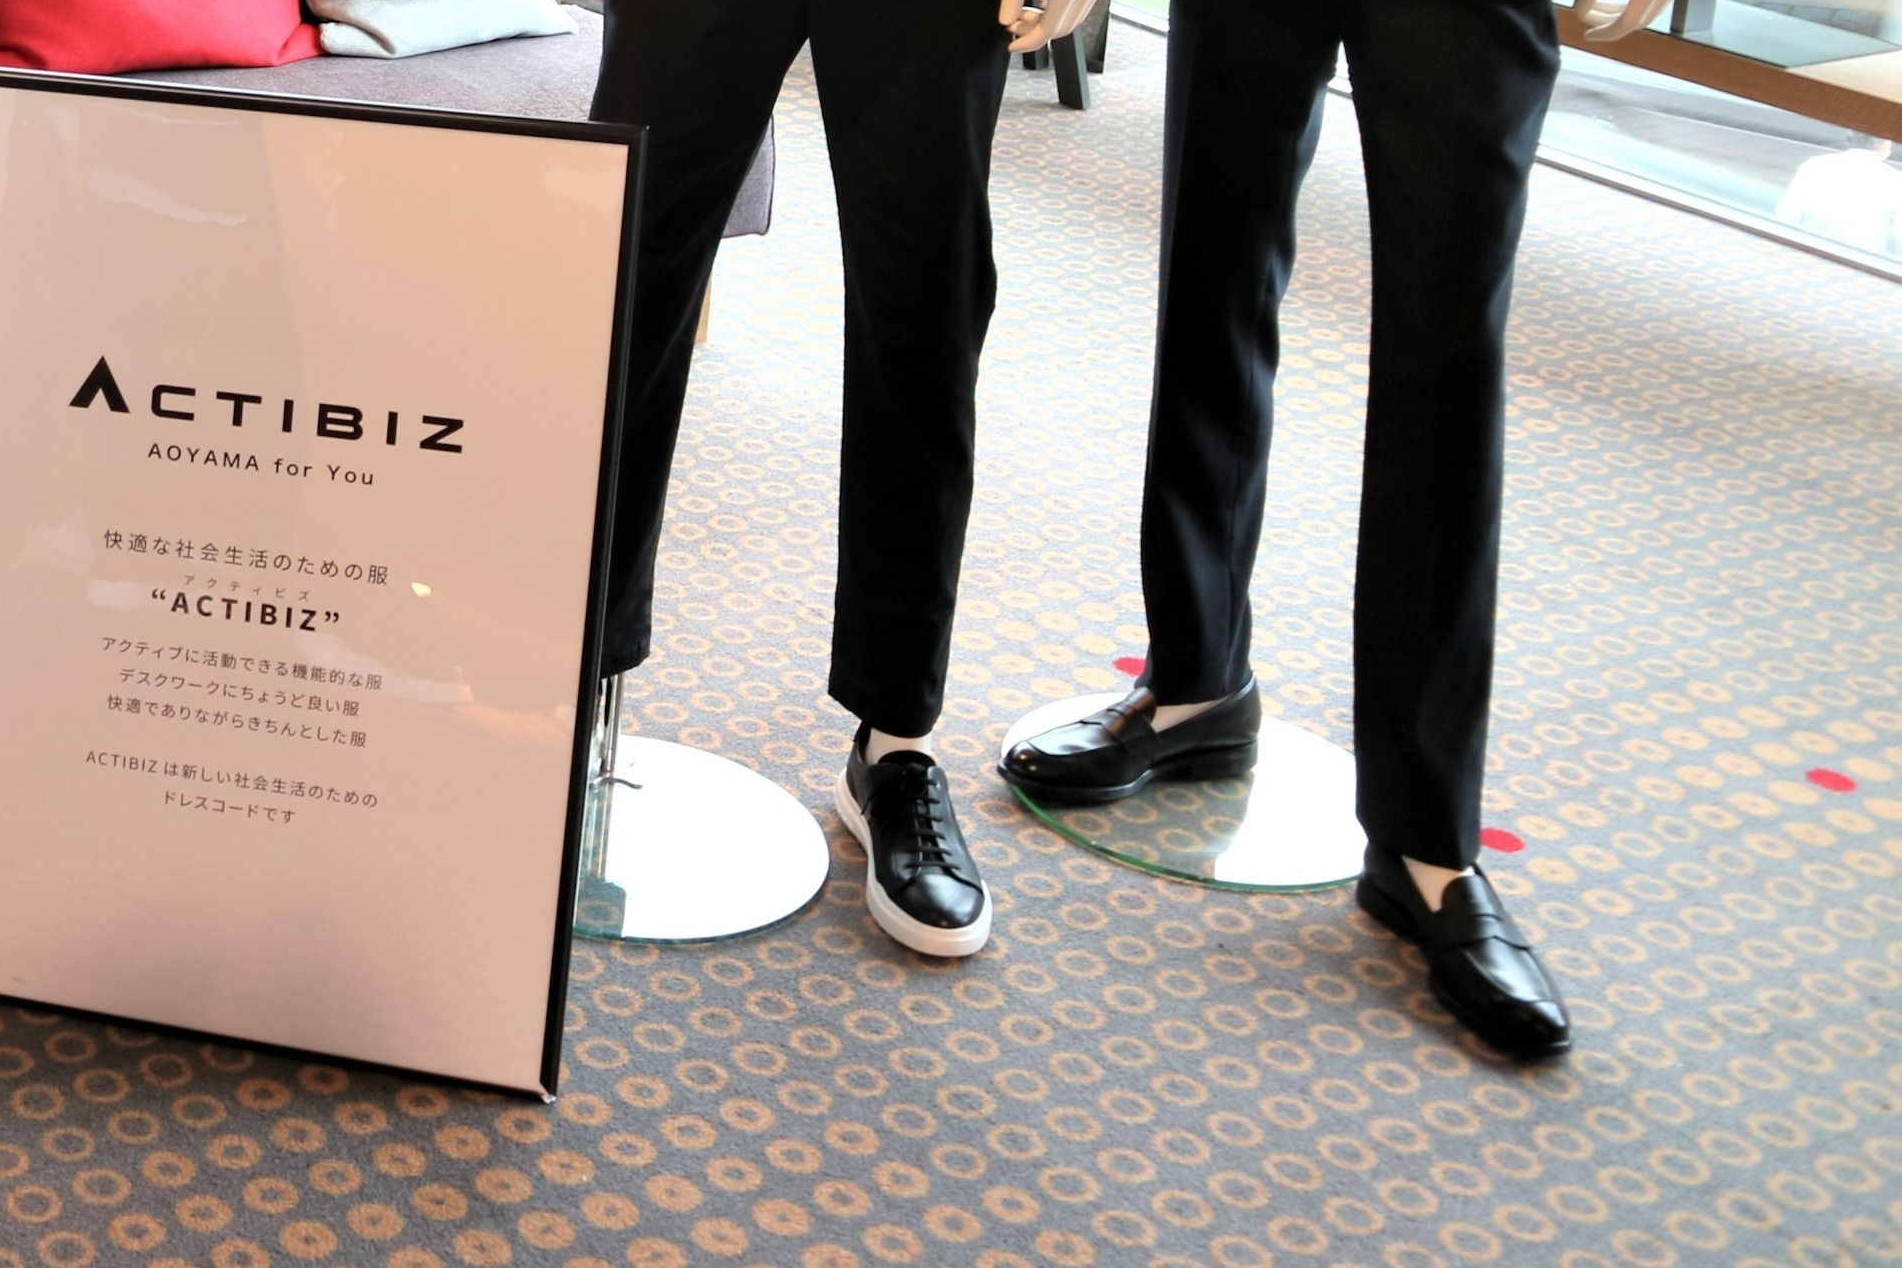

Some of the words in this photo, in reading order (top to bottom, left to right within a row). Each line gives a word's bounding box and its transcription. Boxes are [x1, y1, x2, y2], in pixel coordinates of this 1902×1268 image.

[68, 355, 465, 454] ACTIBIZ
[148, 442, 260, 472] AOYAMA
[273, 457, 313, 478] for
[328, 464, 375, 486] You
[103, 529, 389, 586] 快適な社会生活のための服
[183, 575, 311, 601] アクティビズ
[101, 636, 384, 691] アクティブに活動できる機能的な服
[118, 667, 360, 717] デスクワークにちょうど良い服
[106, 694, 368, 748] 快適でありながらきちんとした服
[85, 750, 159, 774] ACTIBIZ
[163, 762, 379, 808] は新しい社会生活のための
[163, 790, 296, 825] ドレスコードです
